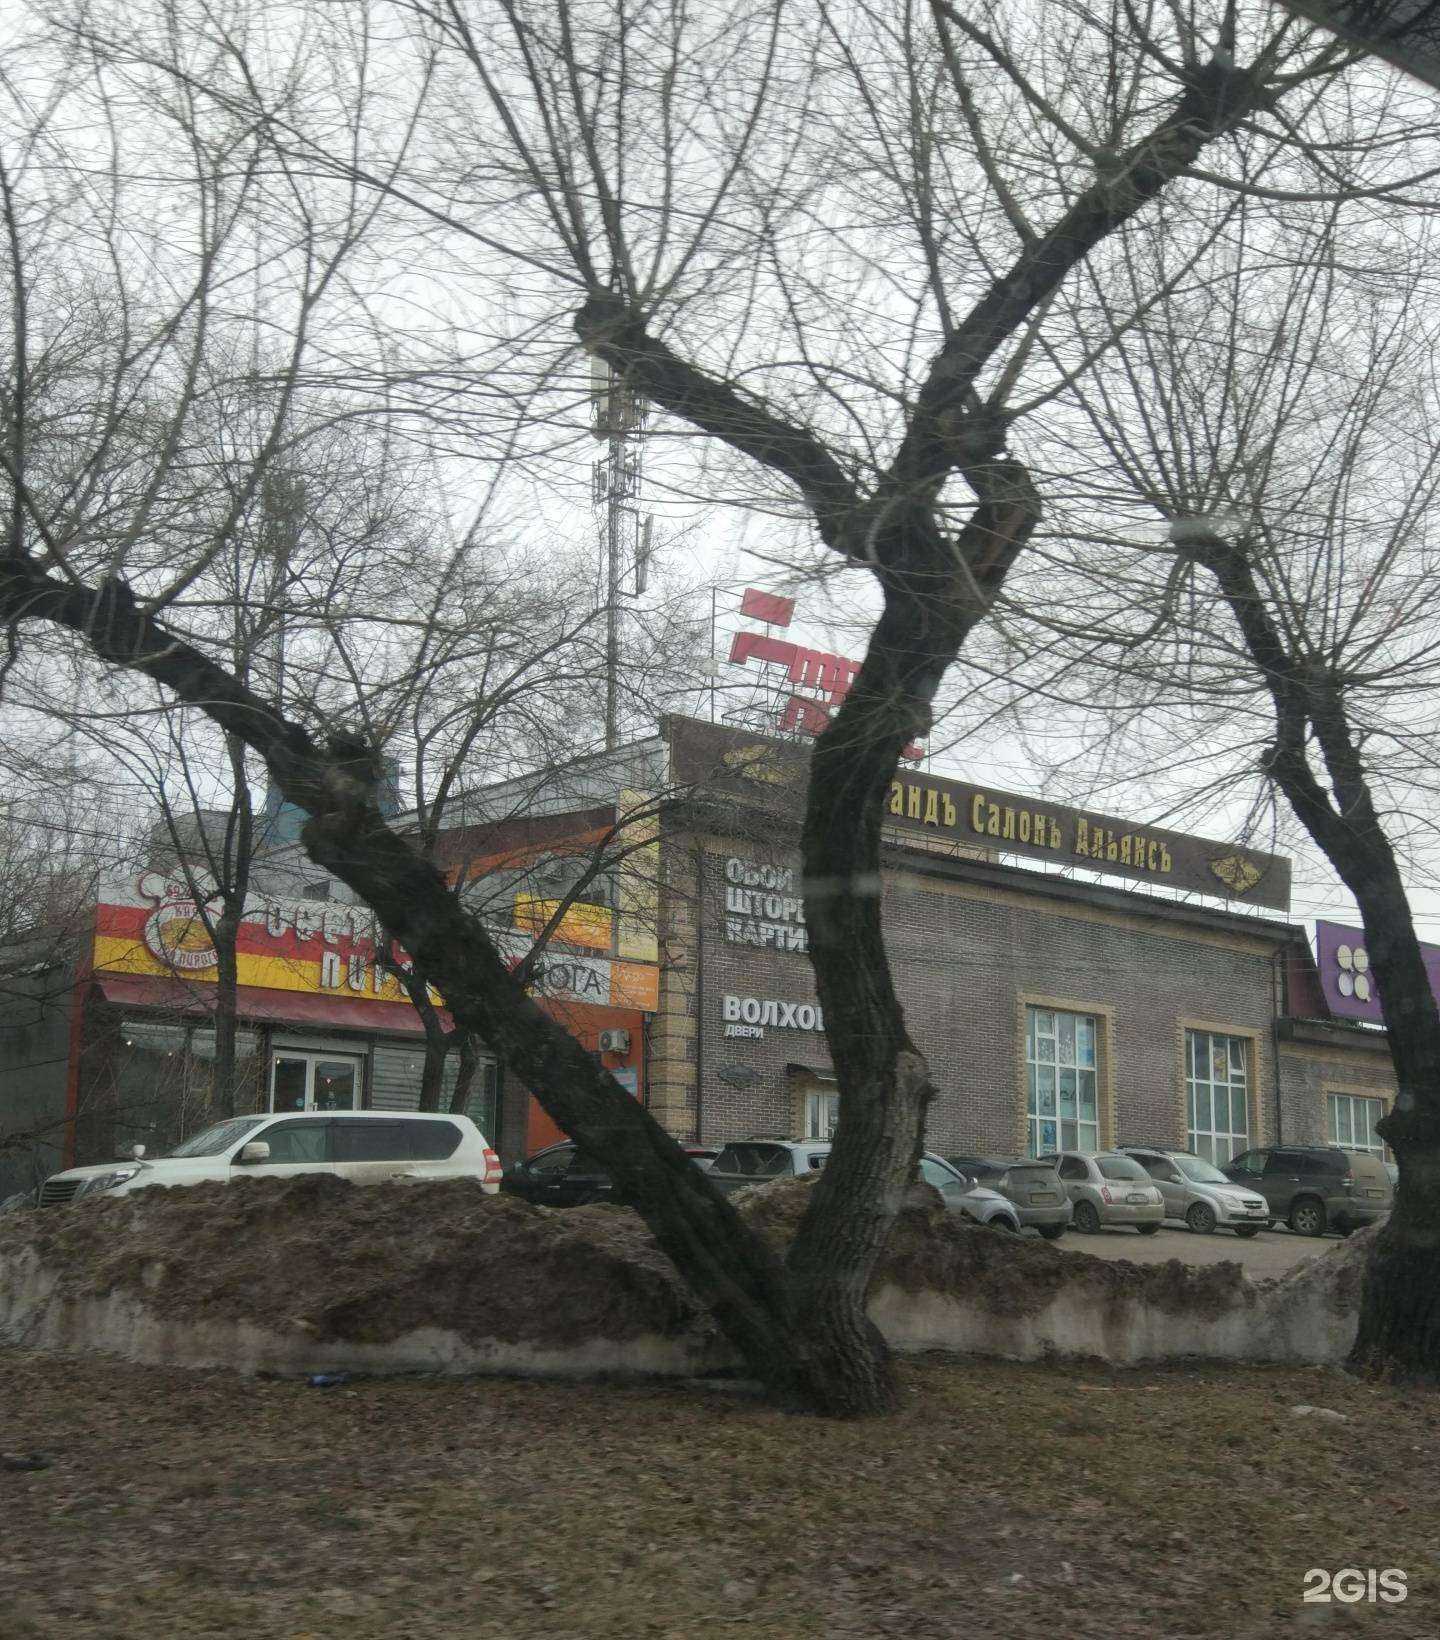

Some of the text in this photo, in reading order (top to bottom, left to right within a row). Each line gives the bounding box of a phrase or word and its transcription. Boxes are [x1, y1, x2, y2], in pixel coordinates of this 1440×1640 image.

[889, 781, 1173, 874] андъ Салонъ Альянсъ
[726, 916, 811, 953] КАРТИ
[724, 1024, 764, 1039] ДВЕРИ
